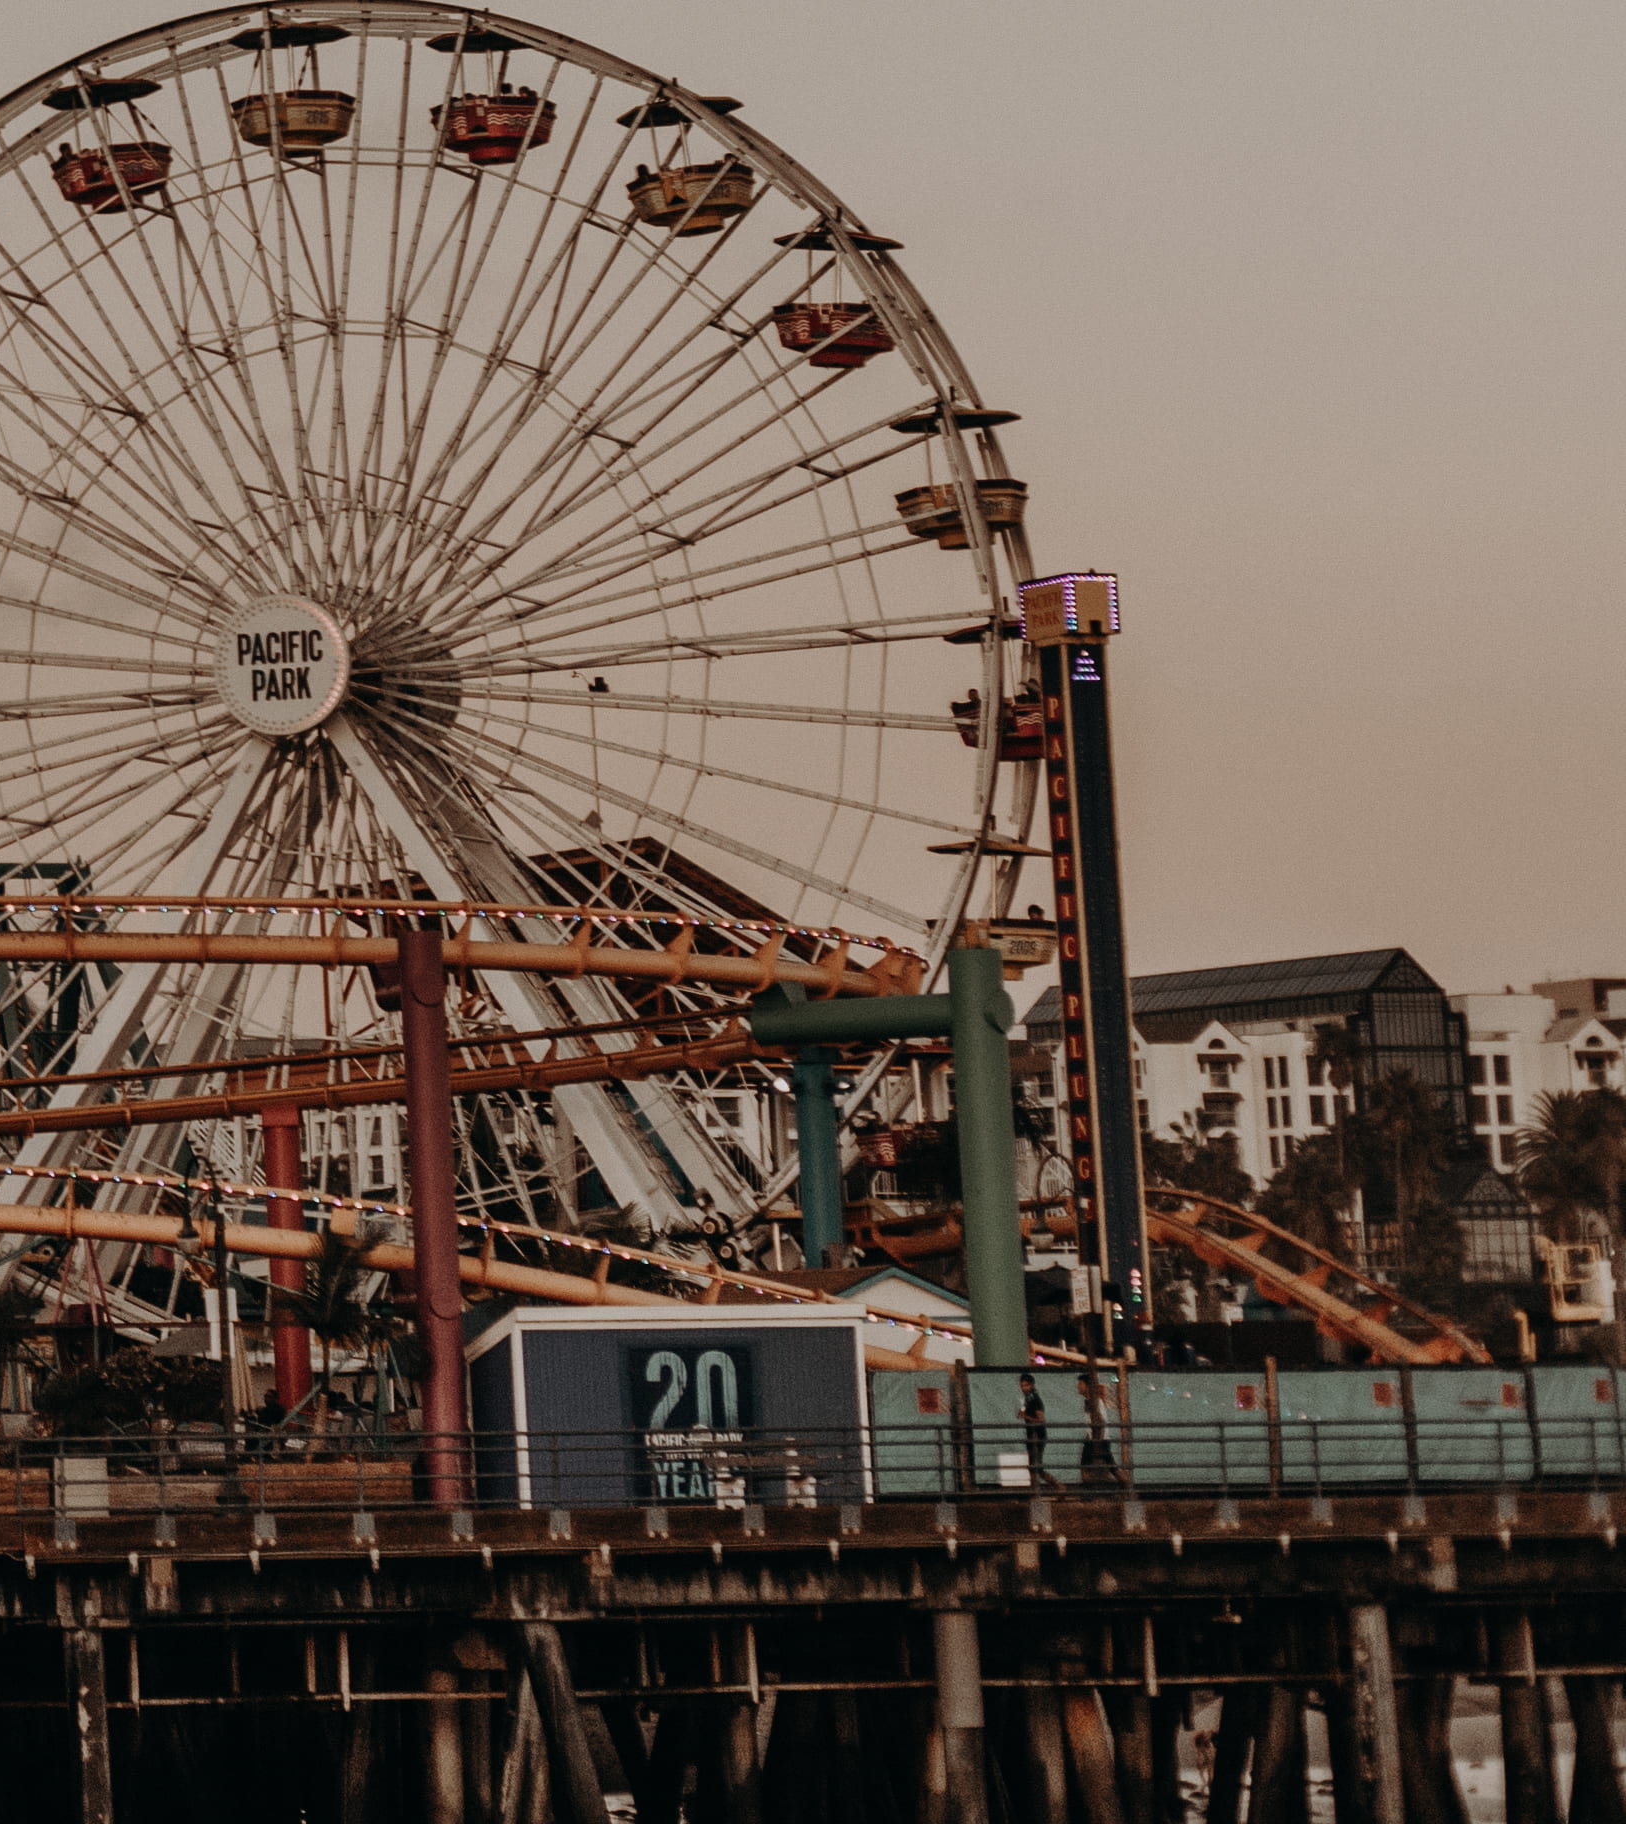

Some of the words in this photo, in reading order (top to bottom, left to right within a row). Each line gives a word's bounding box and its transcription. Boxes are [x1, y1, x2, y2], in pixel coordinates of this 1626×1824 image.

[1032, 612, 1061, 628] PARK
[237, 629, 323, 666] PACIFIC
[251, 666, 312, 702] PARK
[1047, 696, 1077, 959] PACIFIC
[645, 1349, 740, 1429] 20
[654, 1461, 716, 1499] YEA
